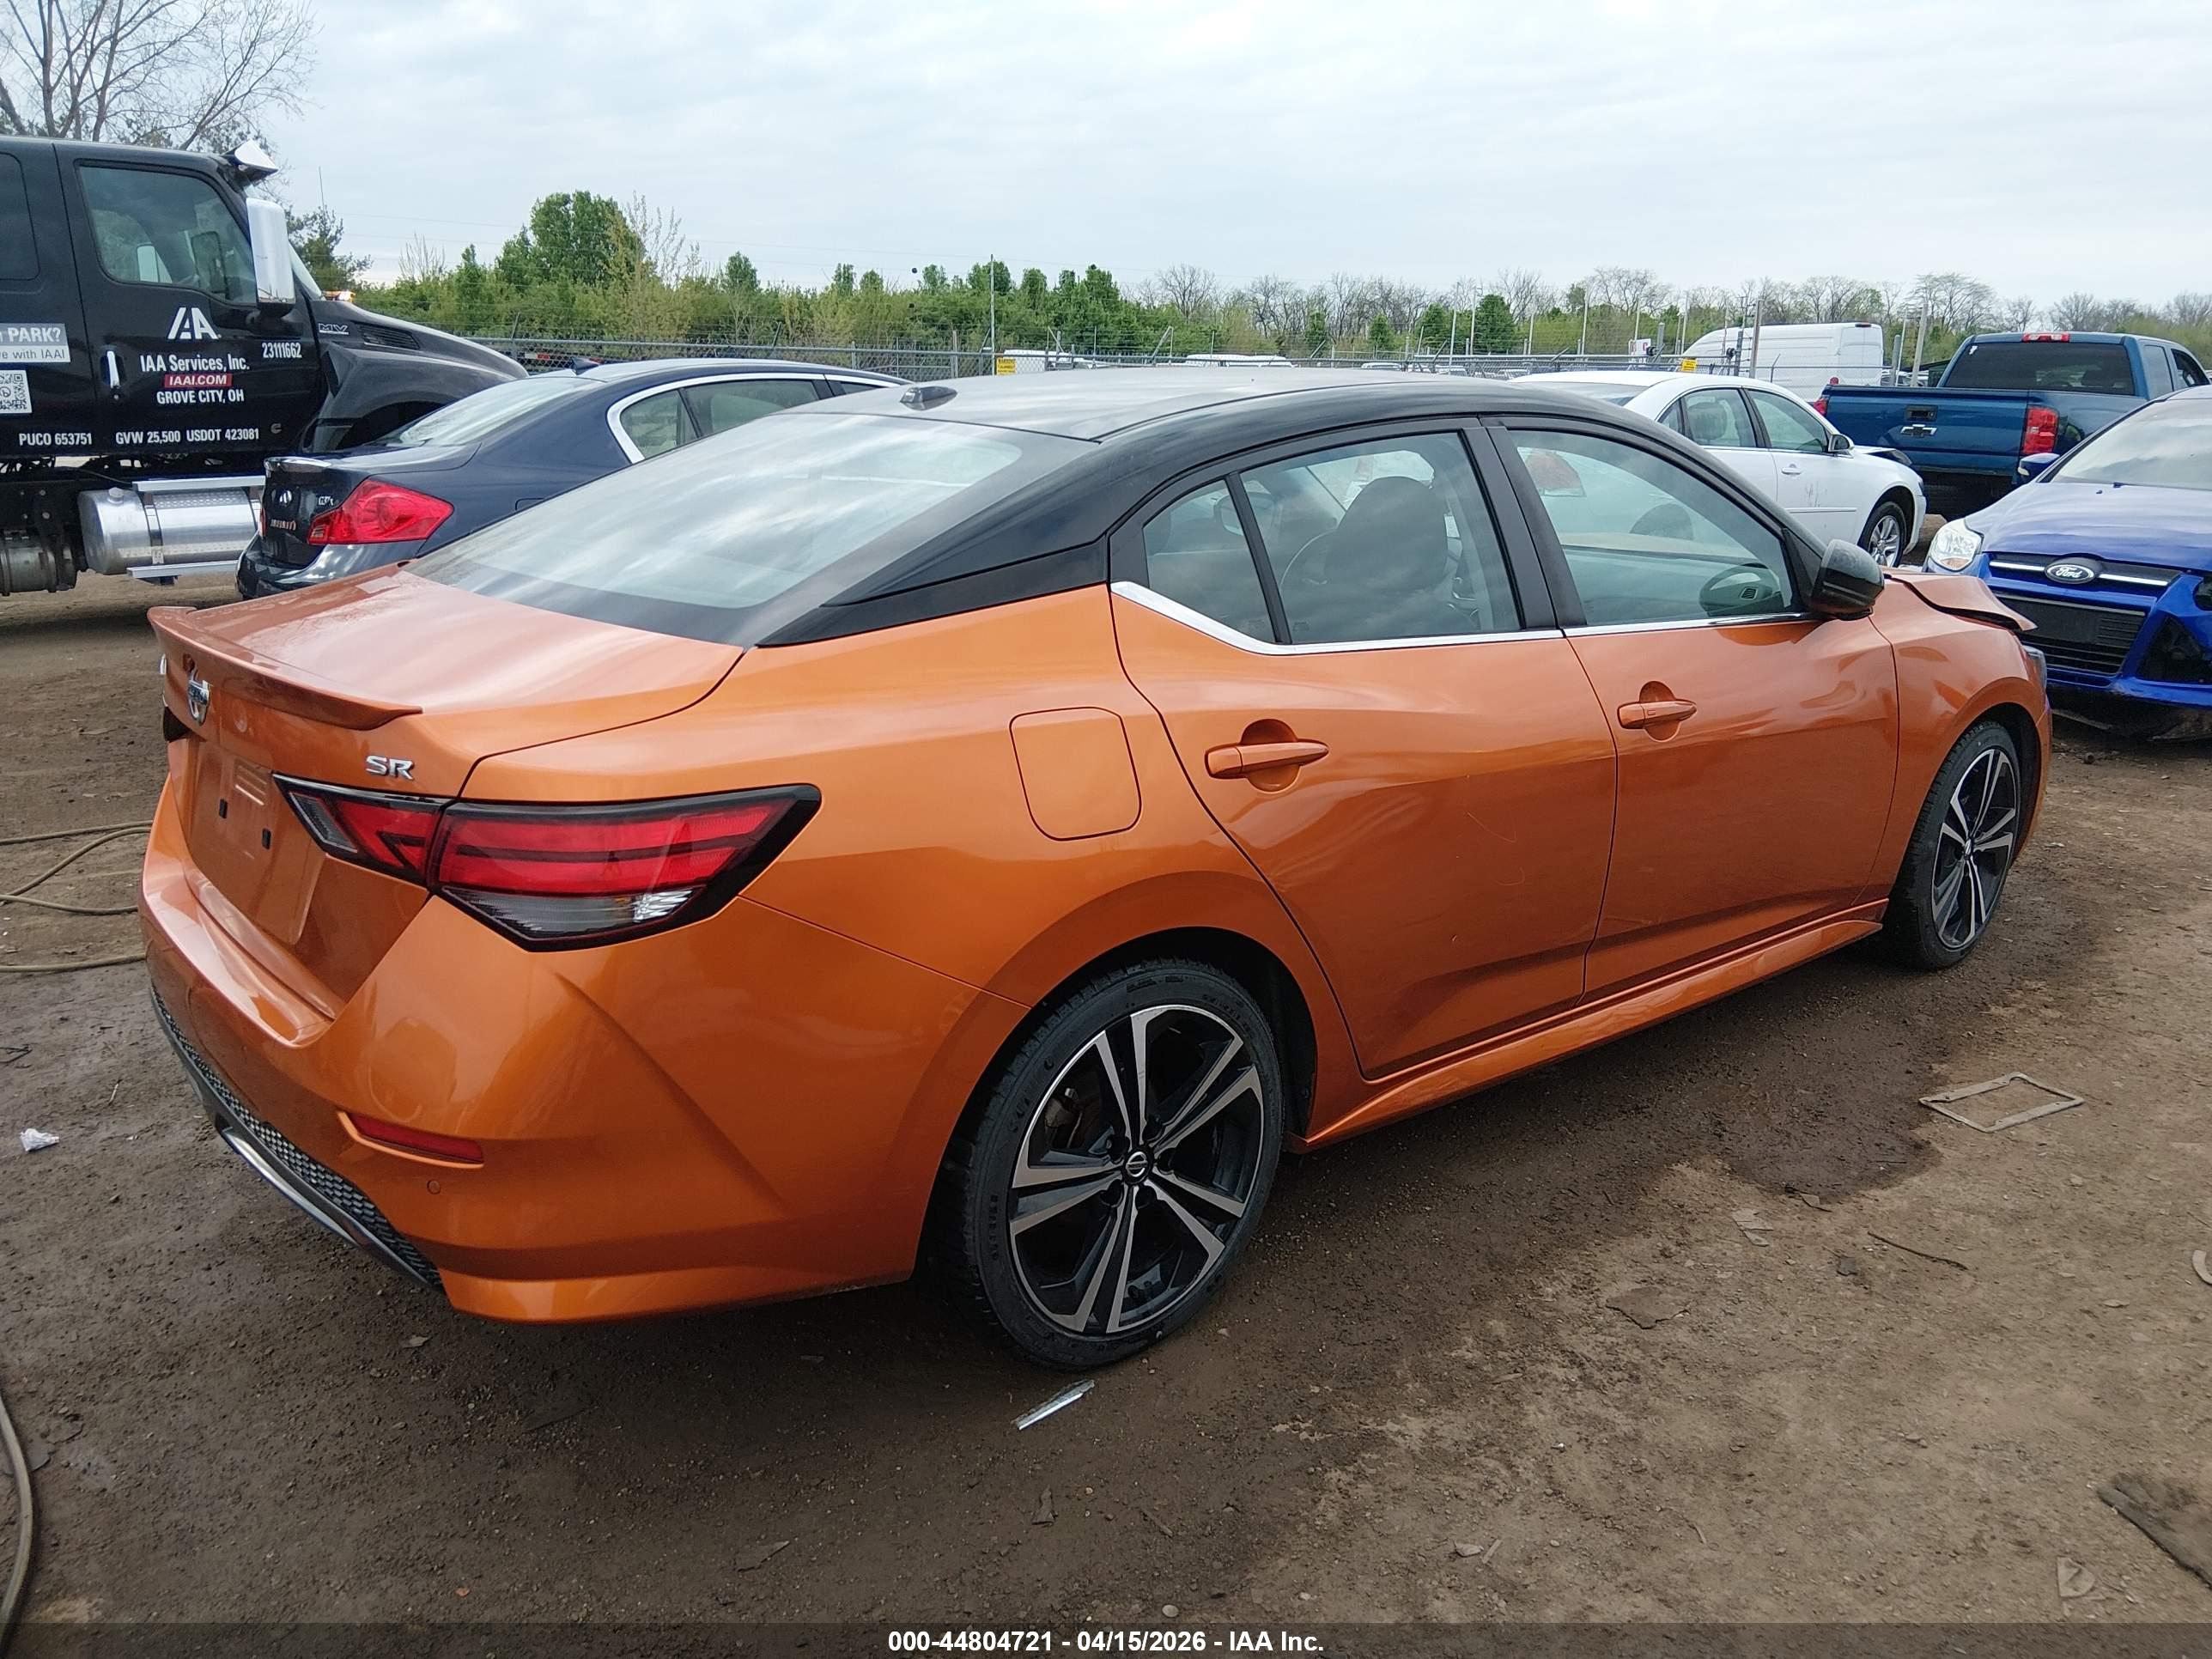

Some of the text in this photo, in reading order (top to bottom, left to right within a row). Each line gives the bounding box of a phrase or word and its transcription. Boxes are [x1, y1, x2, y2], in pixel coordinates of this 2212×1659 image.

[7, 327, 61, 343] PARK?
[12, 349, 37, 359] with
[262, 342, 302, 358] 23111662
[140, 353, 250, 372] IAA Services, Inc.
[169, 374, 227, 386] IAAI.COM
[156, 389, 245, 404] GROVE CITY, OH
[19, 433, 92, 446] PUCO 653751
[115, 428, 259, 445] GVW 25,500 USDOT 423081
[2056, 567, 2083, 578] Ford
[366, 756, 413, 780] SR
